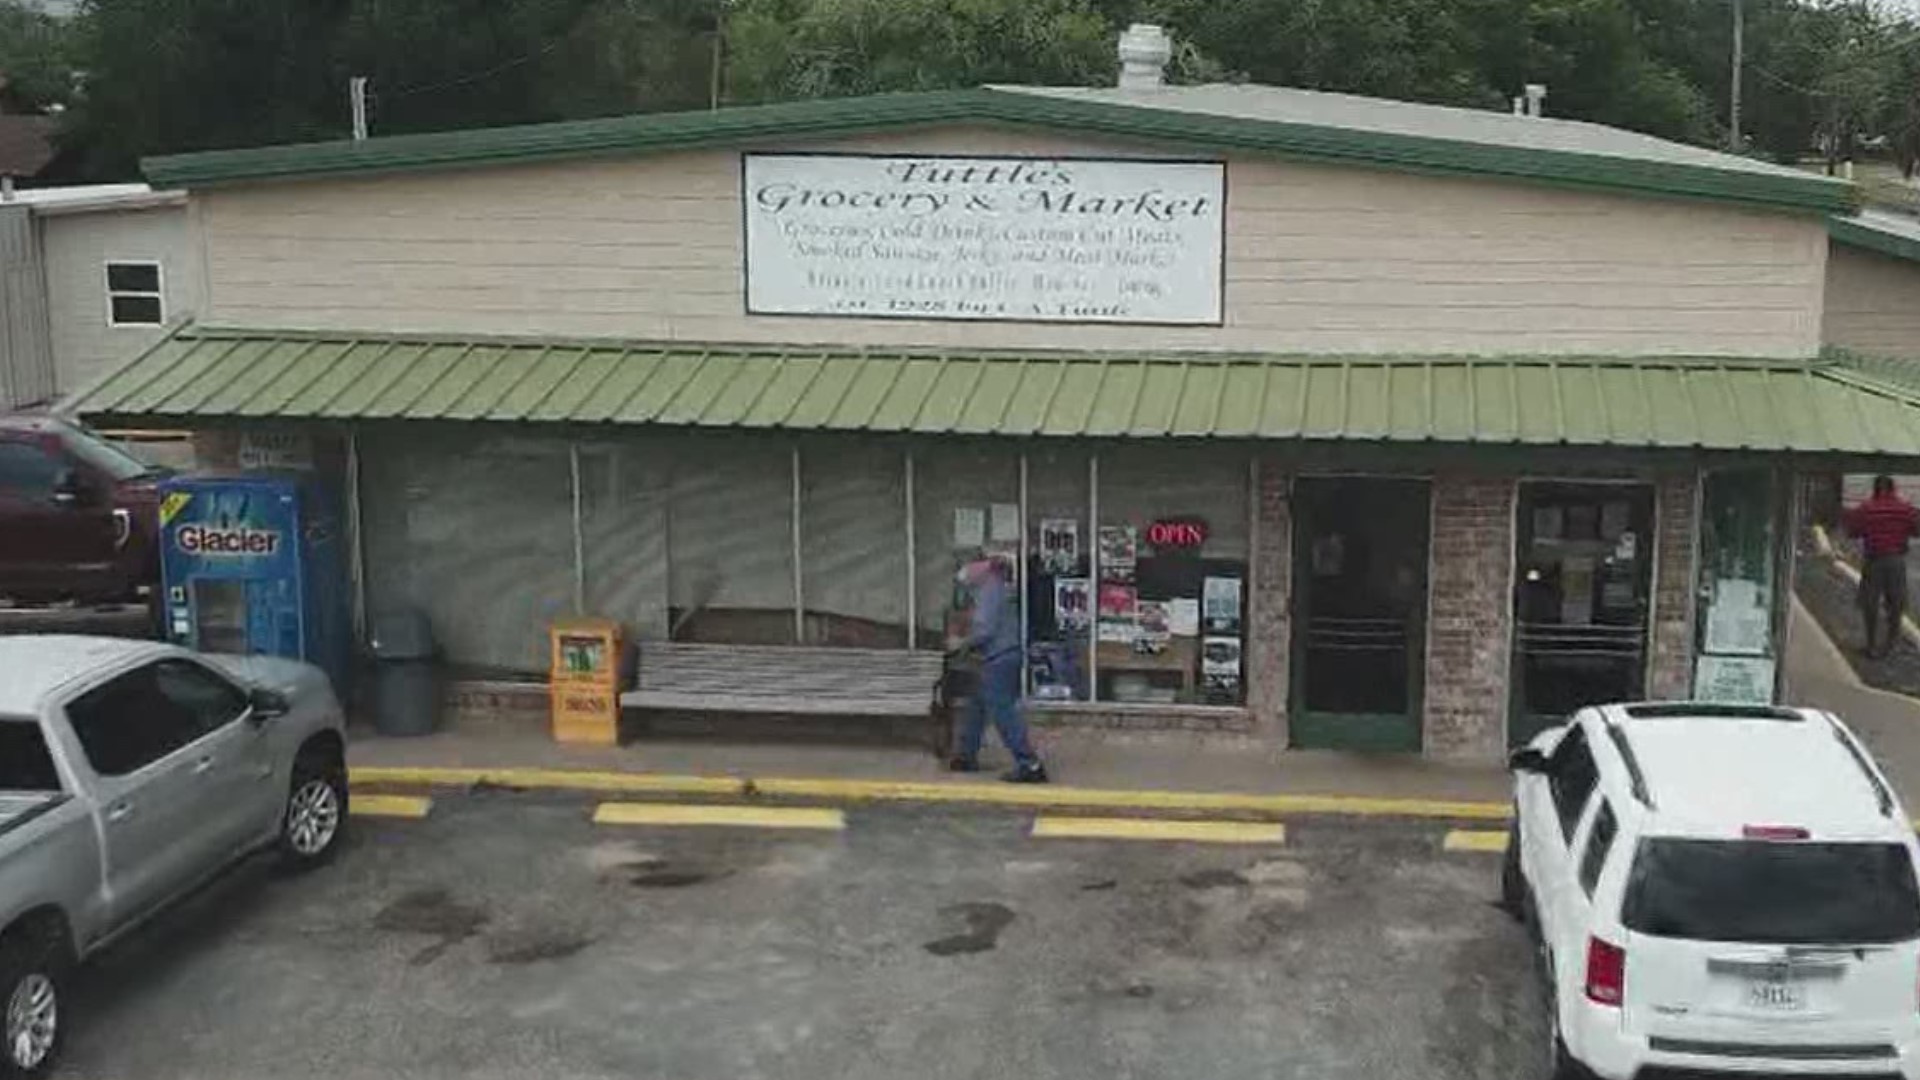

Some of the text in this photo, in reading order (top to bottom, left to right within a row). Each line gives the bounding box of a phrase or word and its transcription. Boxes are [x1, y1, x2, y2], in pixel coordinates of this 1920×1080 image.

[756, 183, 1209, 222] Grocery & Market
[177, 524, 282, 555] Glacier
[1151, 523, 1201, 543] OPEN
